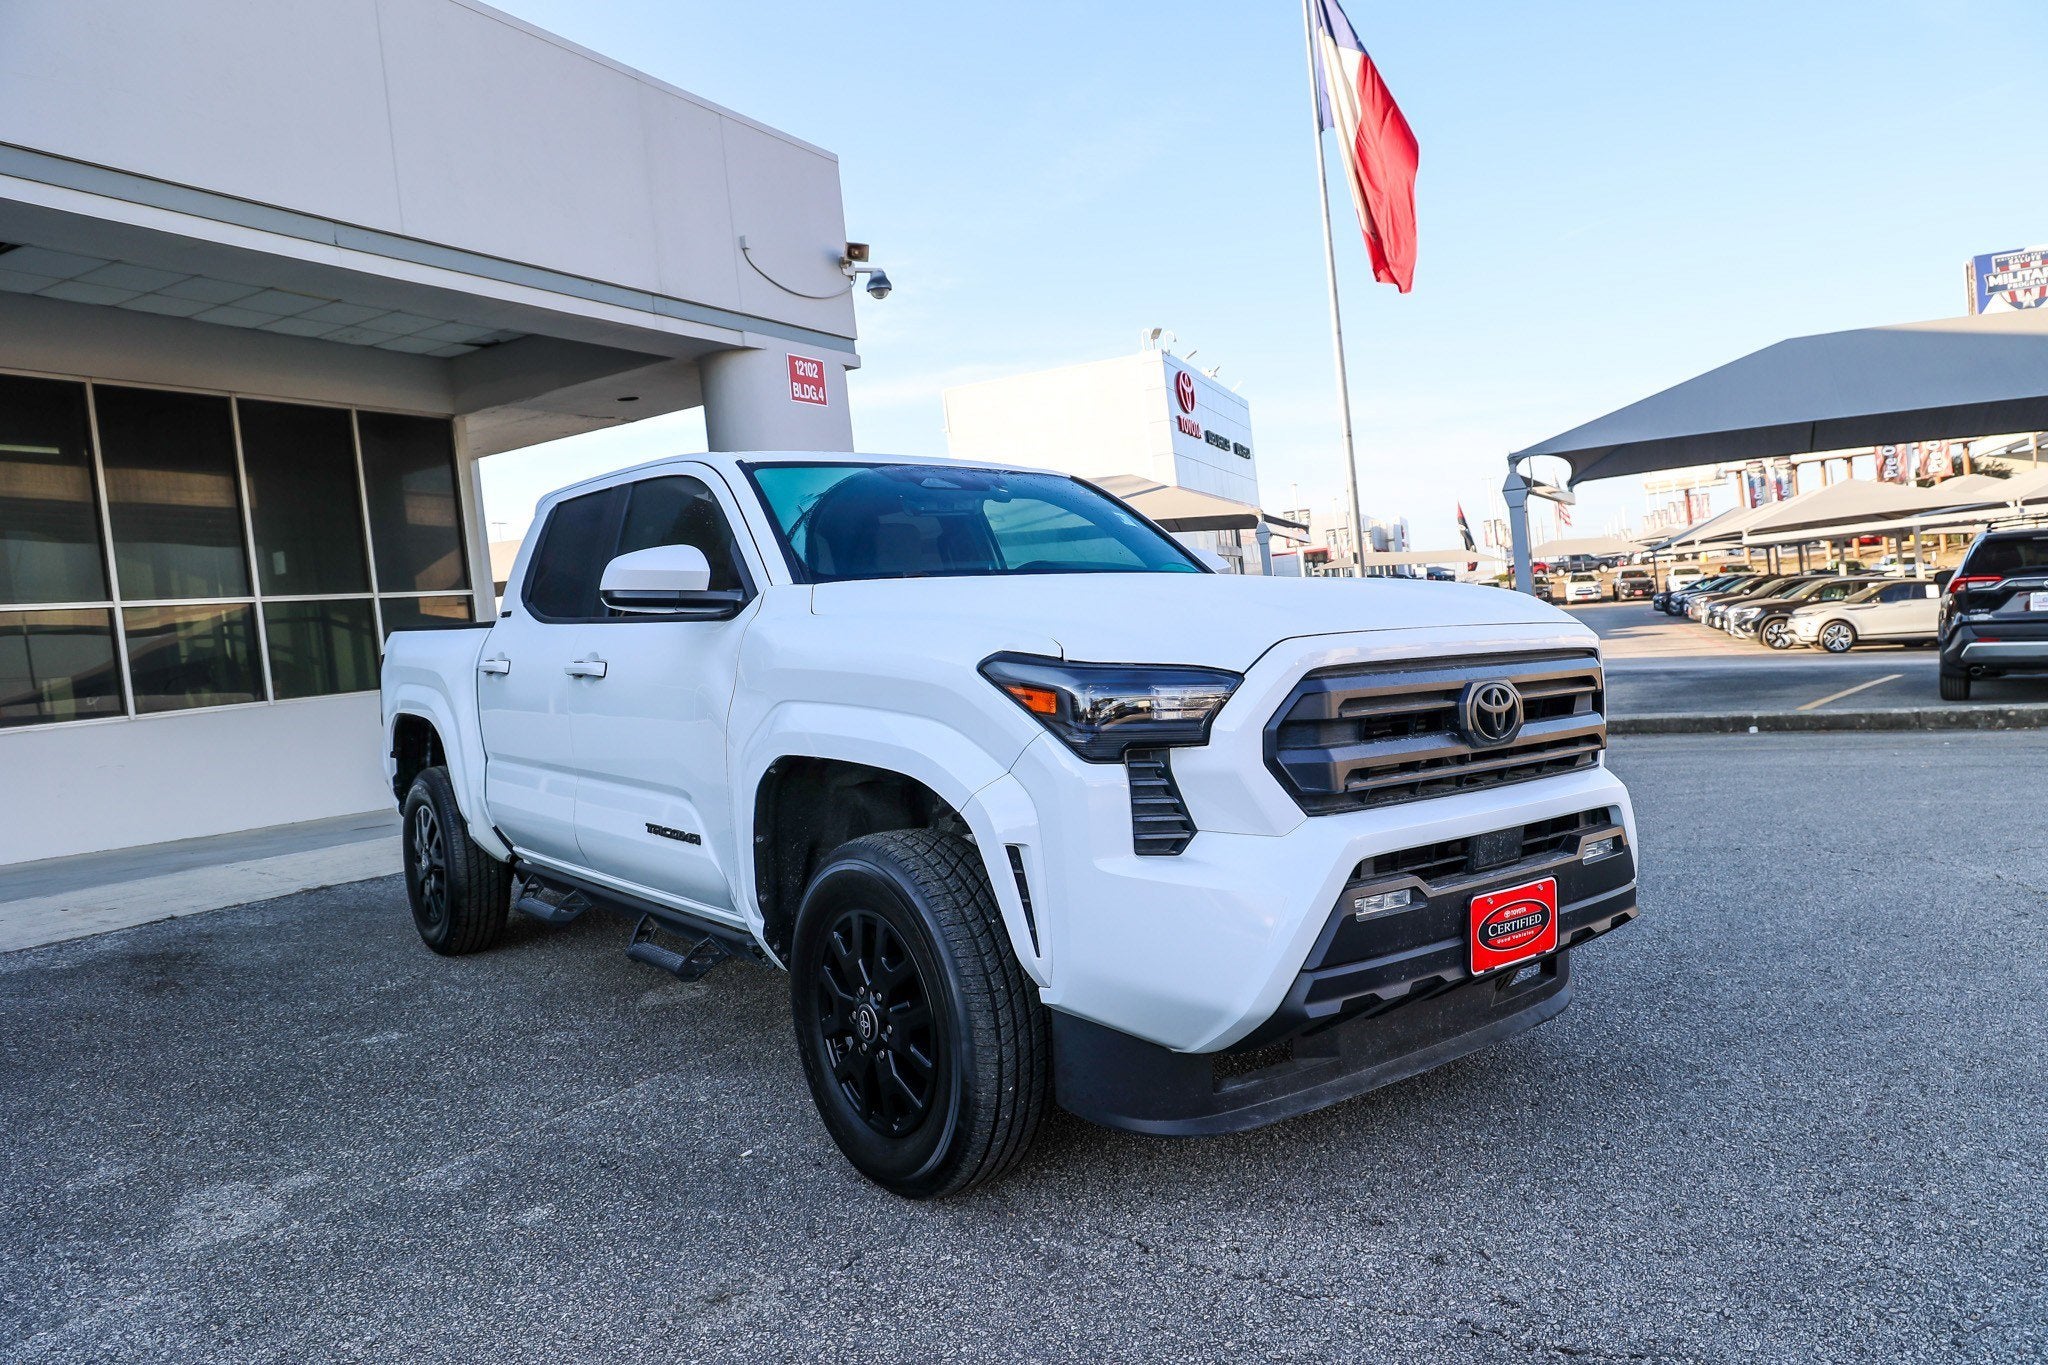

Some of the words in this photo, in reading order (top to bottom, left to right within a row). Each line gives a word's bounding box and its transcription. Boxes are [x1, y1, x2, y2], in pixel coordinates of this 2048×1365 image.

[795, 360, 819, 379] 12102
[645, 822, 702, 846] TACOMA
[1510, 906, 1527, 916] TOYOTA
[1488, 914, 1542, 937] CERTIFIED
[1496, 936, 1511, 944] Used
